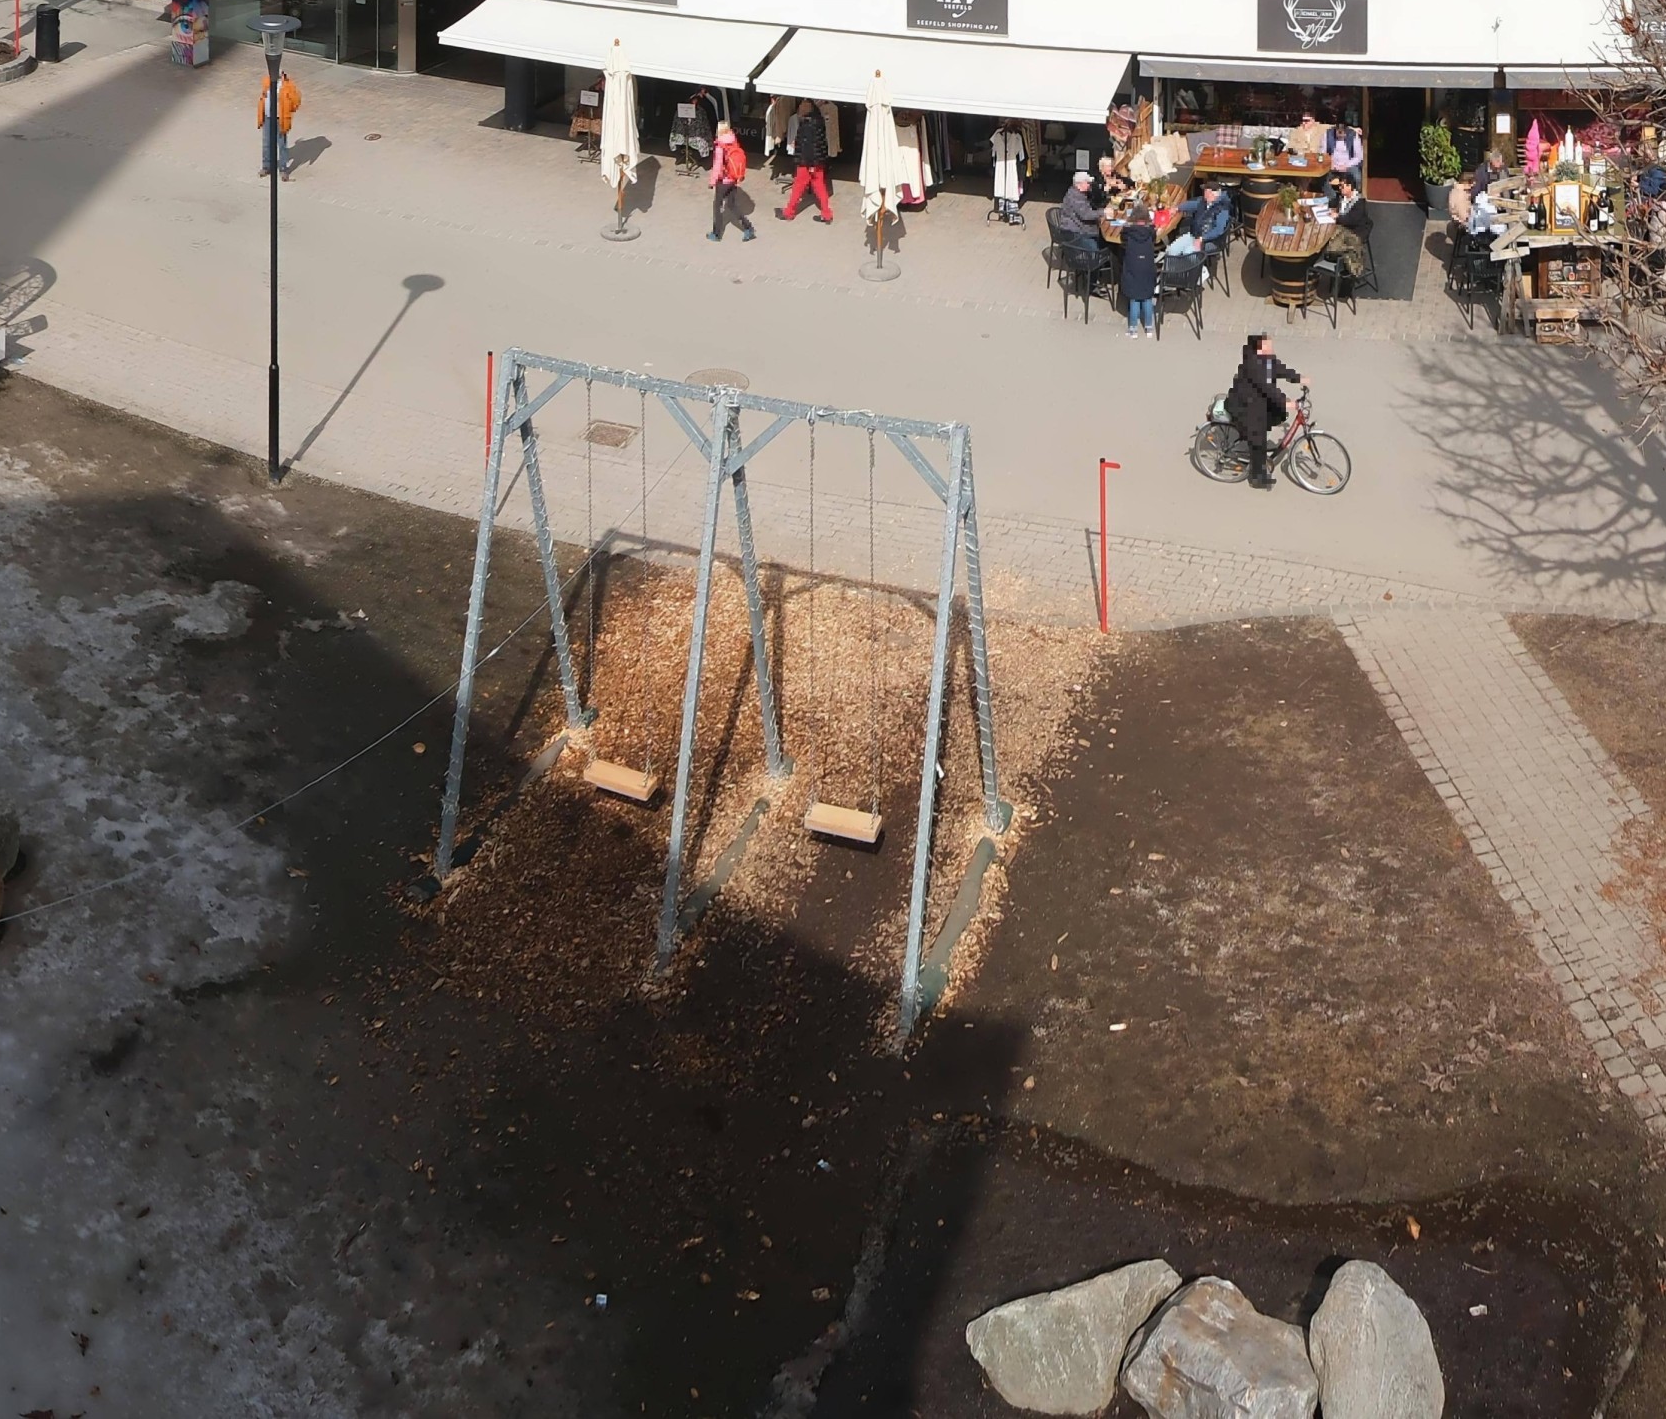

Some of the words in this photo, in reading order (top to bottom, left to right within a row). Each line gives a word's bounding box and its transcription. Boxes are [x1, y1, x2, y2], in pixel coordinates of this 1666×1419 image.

[944, 3, 973, 11] SEEFELD
[916, 19, 946, 28] SEEFELD
[947, 22, 983, 30] SHOPPING
